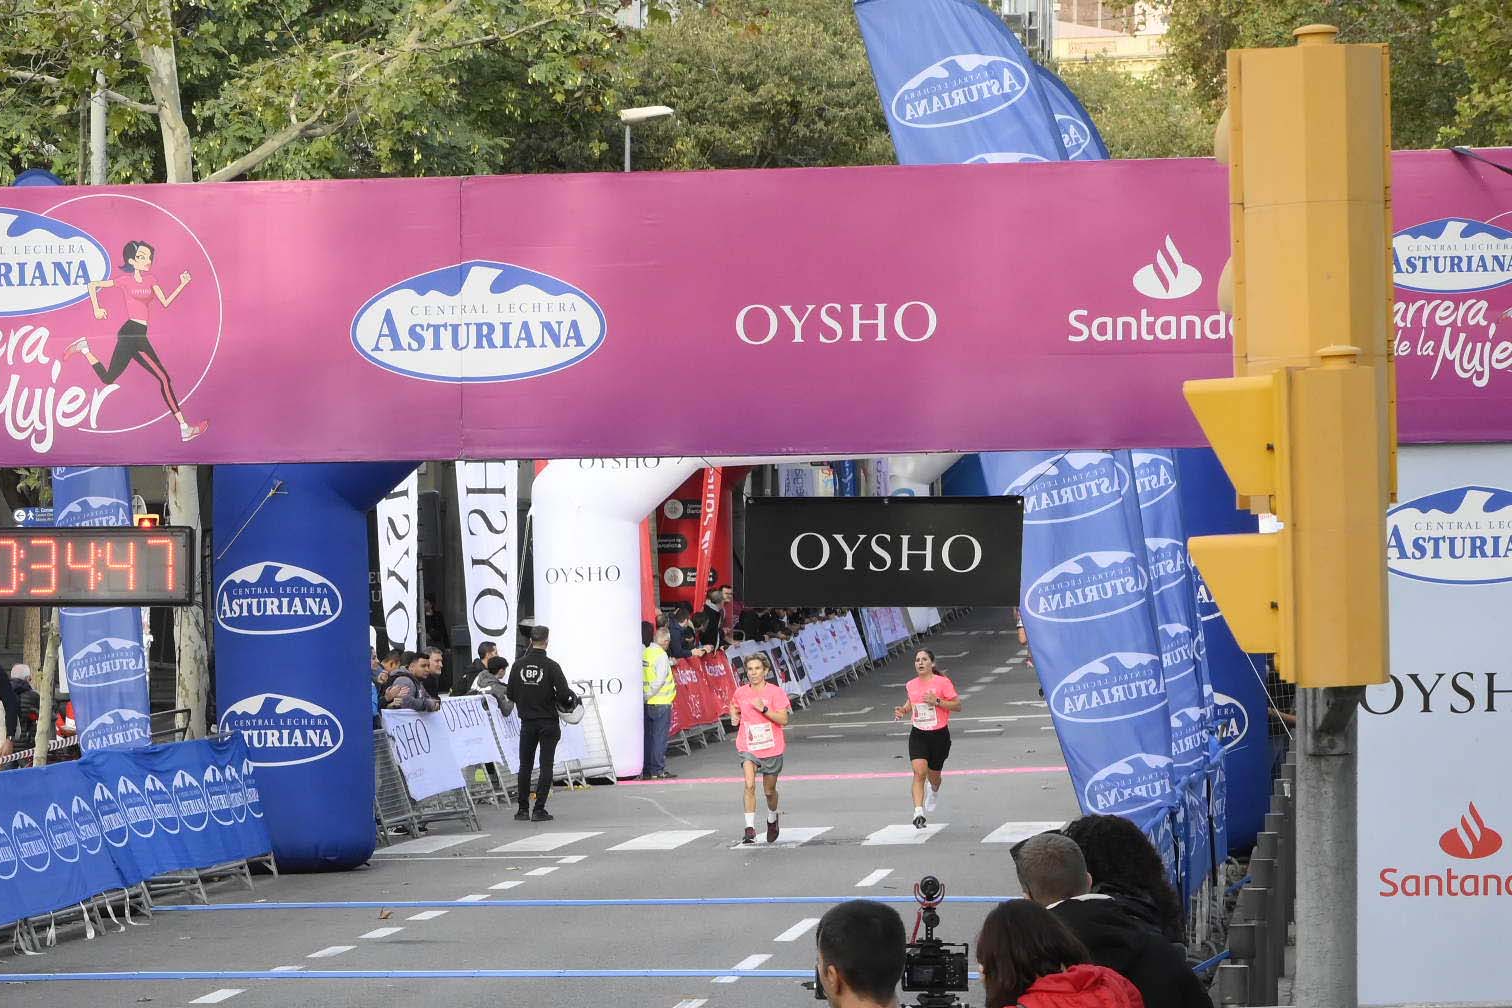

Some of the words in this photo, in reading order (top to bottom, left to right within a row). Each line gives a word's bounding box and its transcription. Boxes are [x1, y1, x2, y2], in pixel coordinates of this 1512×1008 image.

[13, 245, 86, 254] LECHERA
[1407, 244, 1459, 252] CENTRAL
[410, 305, 490, 316] CENTRAL
[497, 302, 578, 313] LECHERA
[1394, 299, 1488, 328] arrera
[371, 307, 586, 353] ASTURIANA
[736, 301, 937, 345] OYSHO
[1068, 309, 1234, 342] Santand
[1416, 329, 1434, 356] la
[1413, 520, 1481, 531] CENTRAL
[790, 532, 982, 573] OYSHO
[545, 564, 621, 585] OYSHO
[232, 586, 277, 595] CENTRAL
[279, 586, 328, 595] LECHERA
[220, 591, 333, 619] ASTURIANA
[526, 669, 538, 678] BP
[234, 718, 276, 727] CENTRAL
[280, 718, 329, 727] LECHERA
[228, 723, 334, 748] TURIANA
